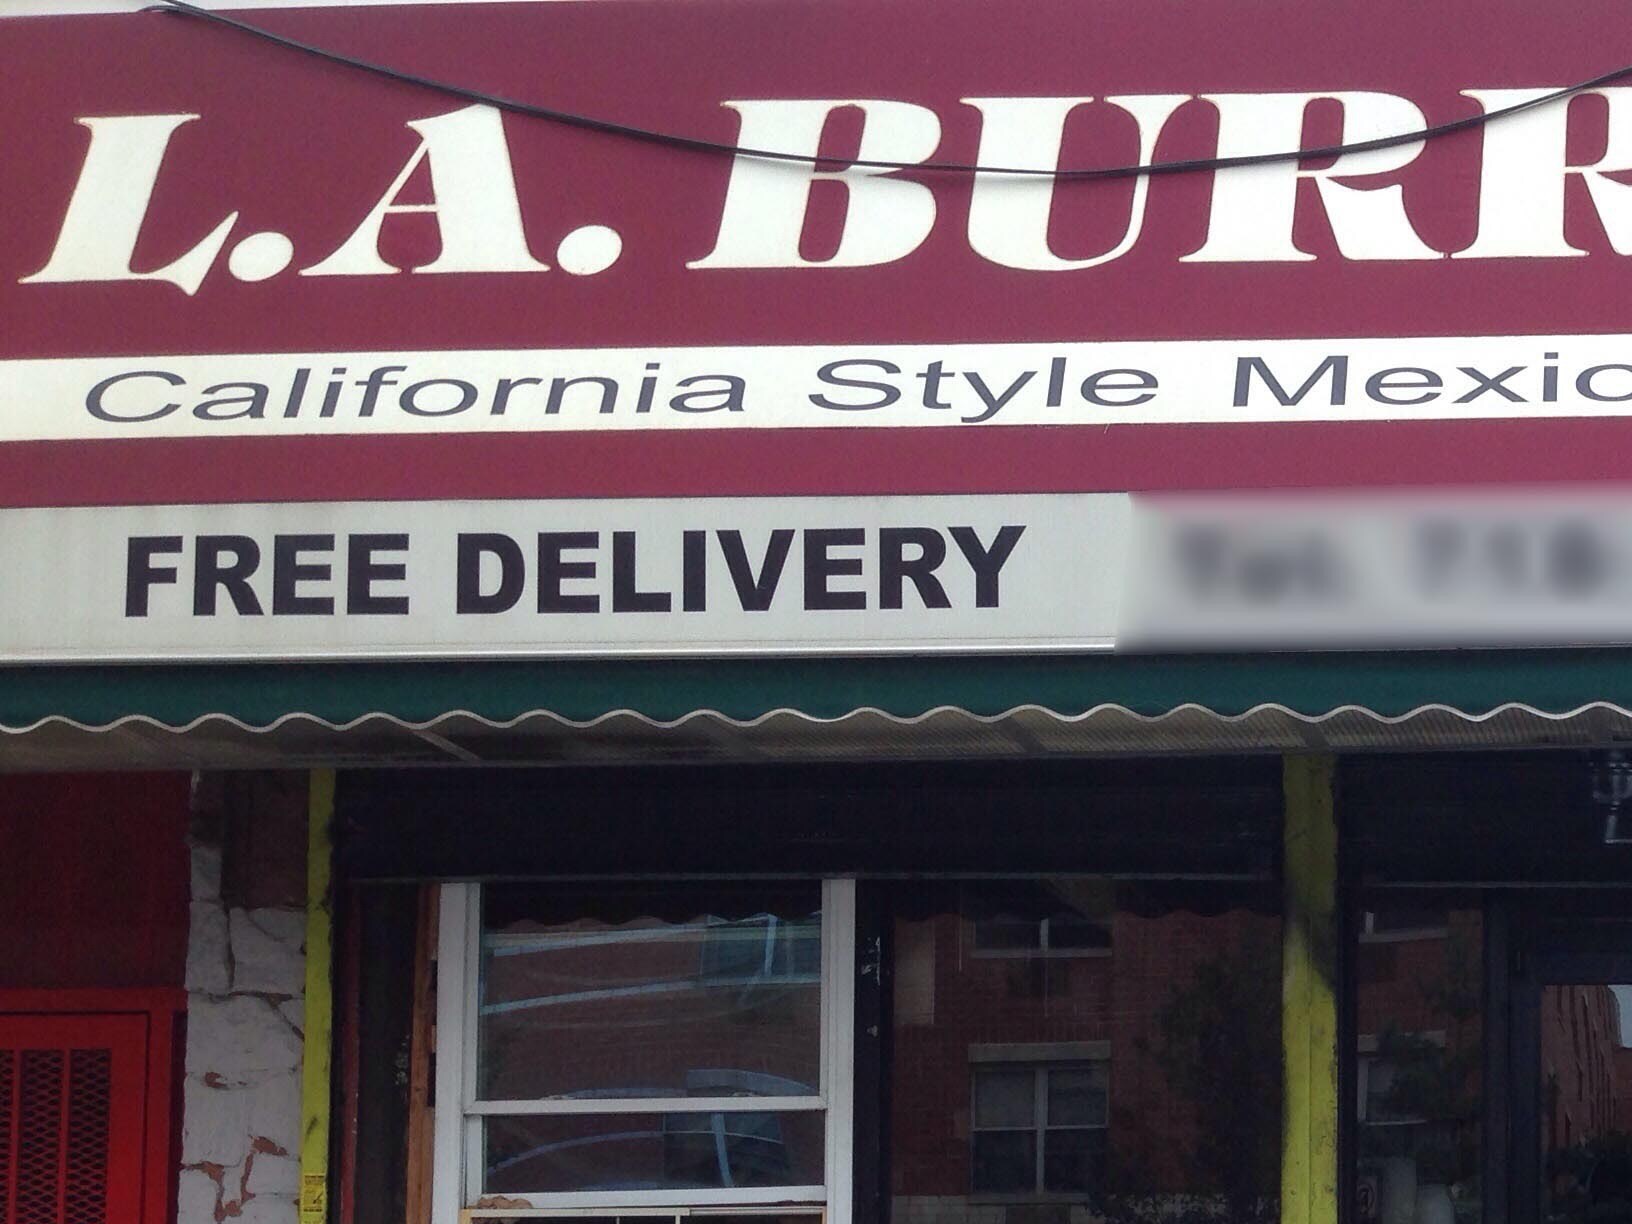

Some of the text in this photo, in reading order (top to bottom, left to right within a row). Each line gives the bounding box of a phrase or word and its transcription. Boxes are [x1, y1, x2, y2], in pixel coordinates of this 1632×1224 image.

[19, 103, 623, 296] L.A.
[84, 363, 747, 424] California
[808, 357, 1160, 424] Style
[125, 525, 1025, 617] FREE DELIVERY
